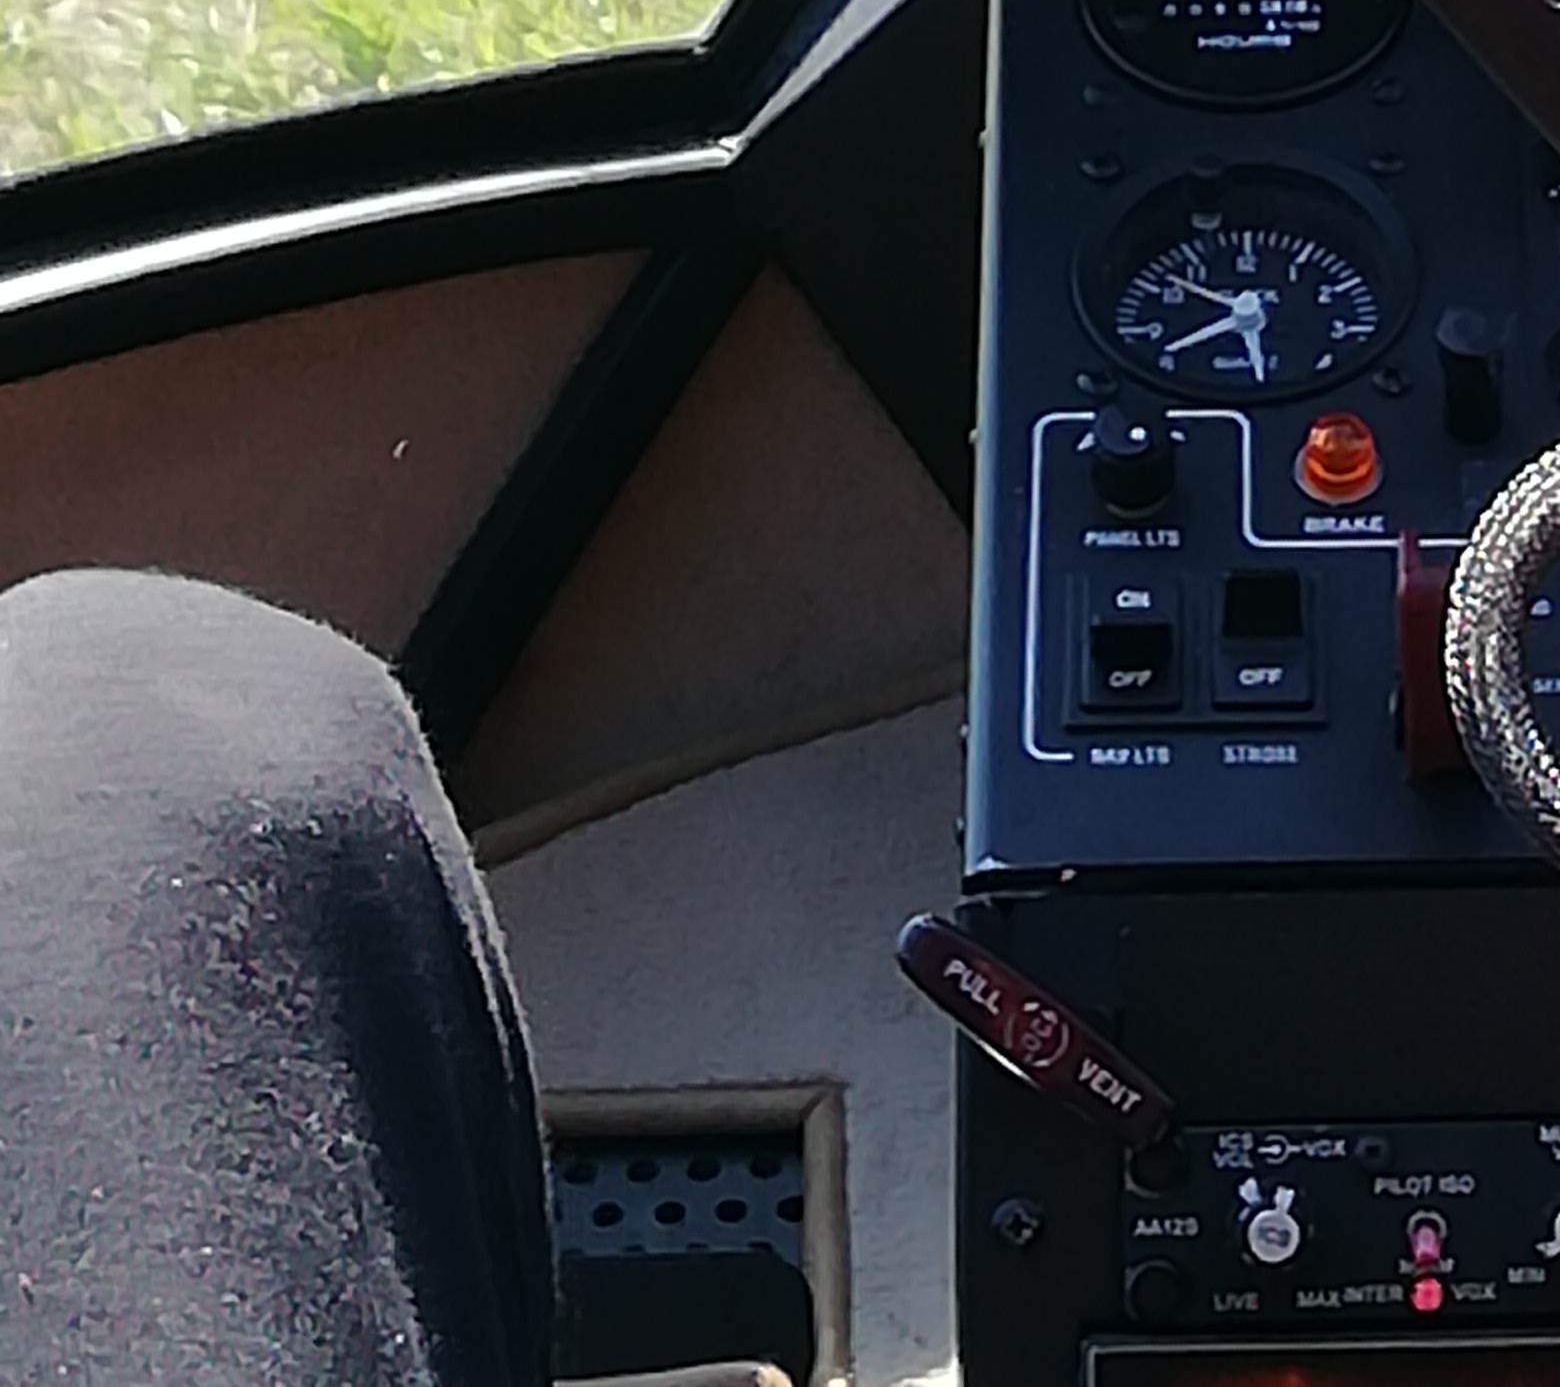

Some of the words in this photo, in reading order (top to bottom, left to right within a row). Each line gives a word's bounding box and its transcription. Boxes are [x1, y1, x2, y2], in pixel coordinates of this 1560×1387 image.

[1303, 516, 1386, 533] BRAKE
[1116, 590, 1151, 608] ON
[1108, 670, 1153, 687] OFF
[1238, 668, 1284, 686] OFF
[943, 959, 1001, 1016] PULL
[1078, 1057, 1142, 1113] VENT
[1373, 1176, 1432, 1197] PILOT
